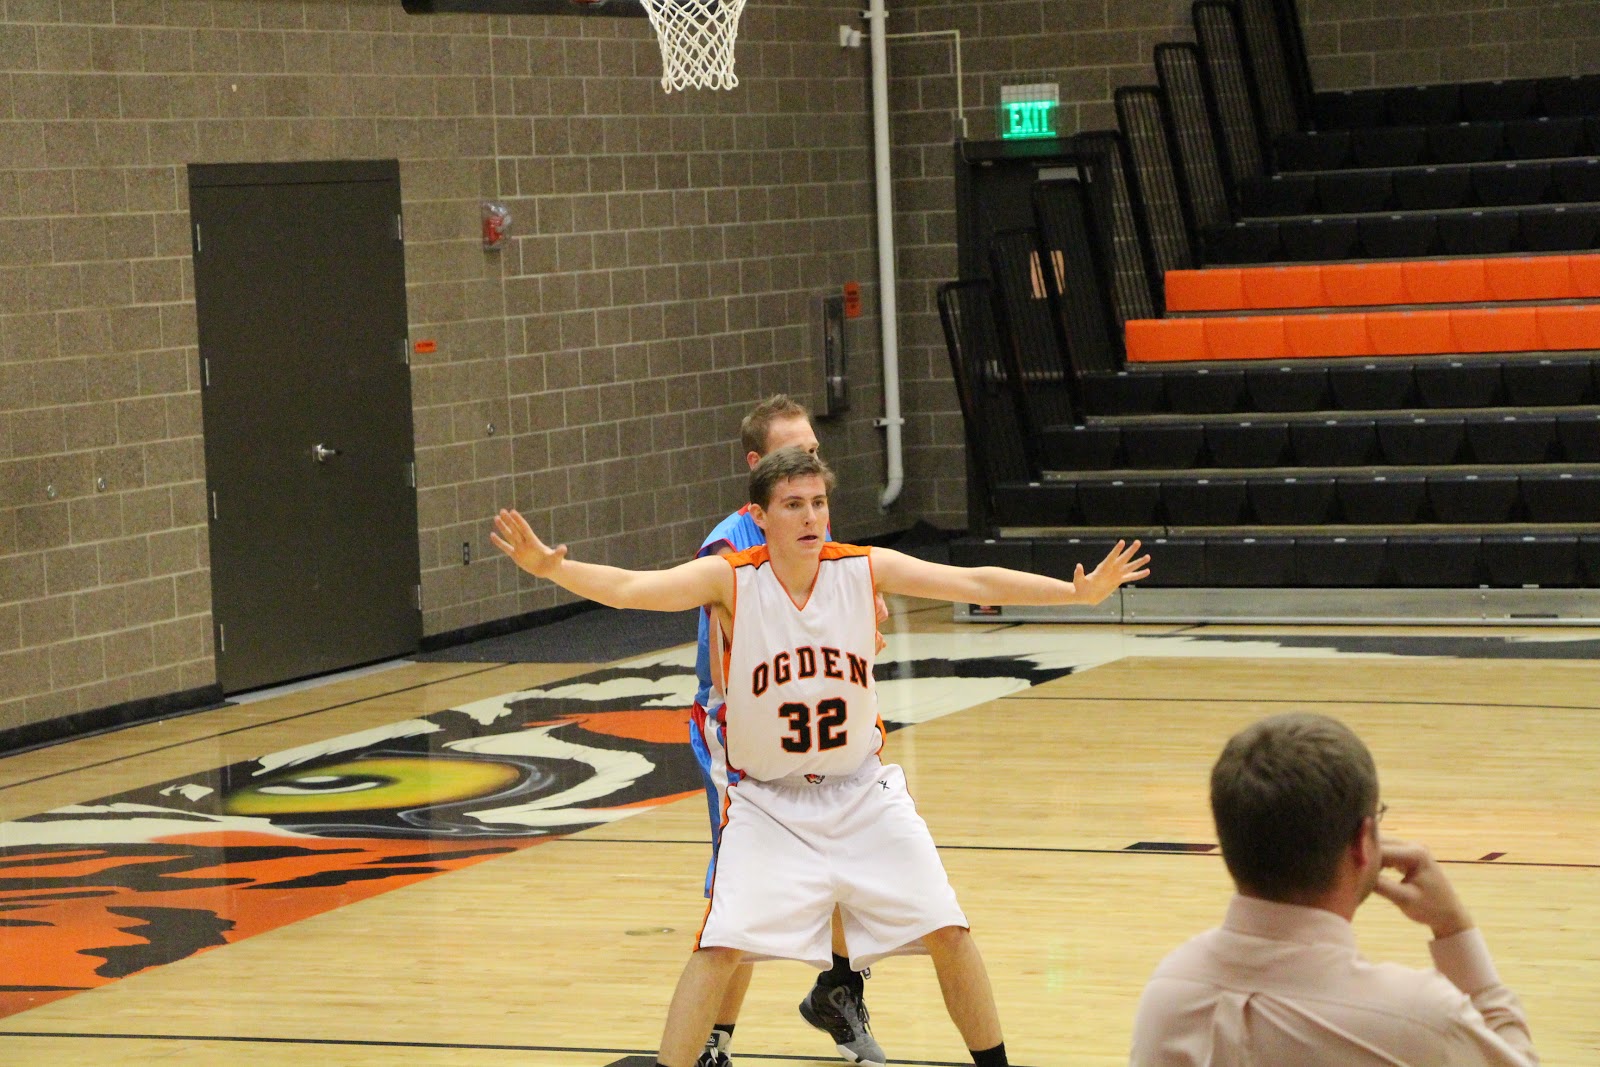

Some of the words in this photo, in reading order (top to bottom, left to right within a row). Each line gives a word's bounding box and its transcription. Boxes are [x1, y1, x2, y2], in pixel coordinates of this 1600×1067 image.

[1009, 101, 1051, 134] EXIT
[752, 645, 868, 698] OGDEN
[778, 697, 847, 754] 32
